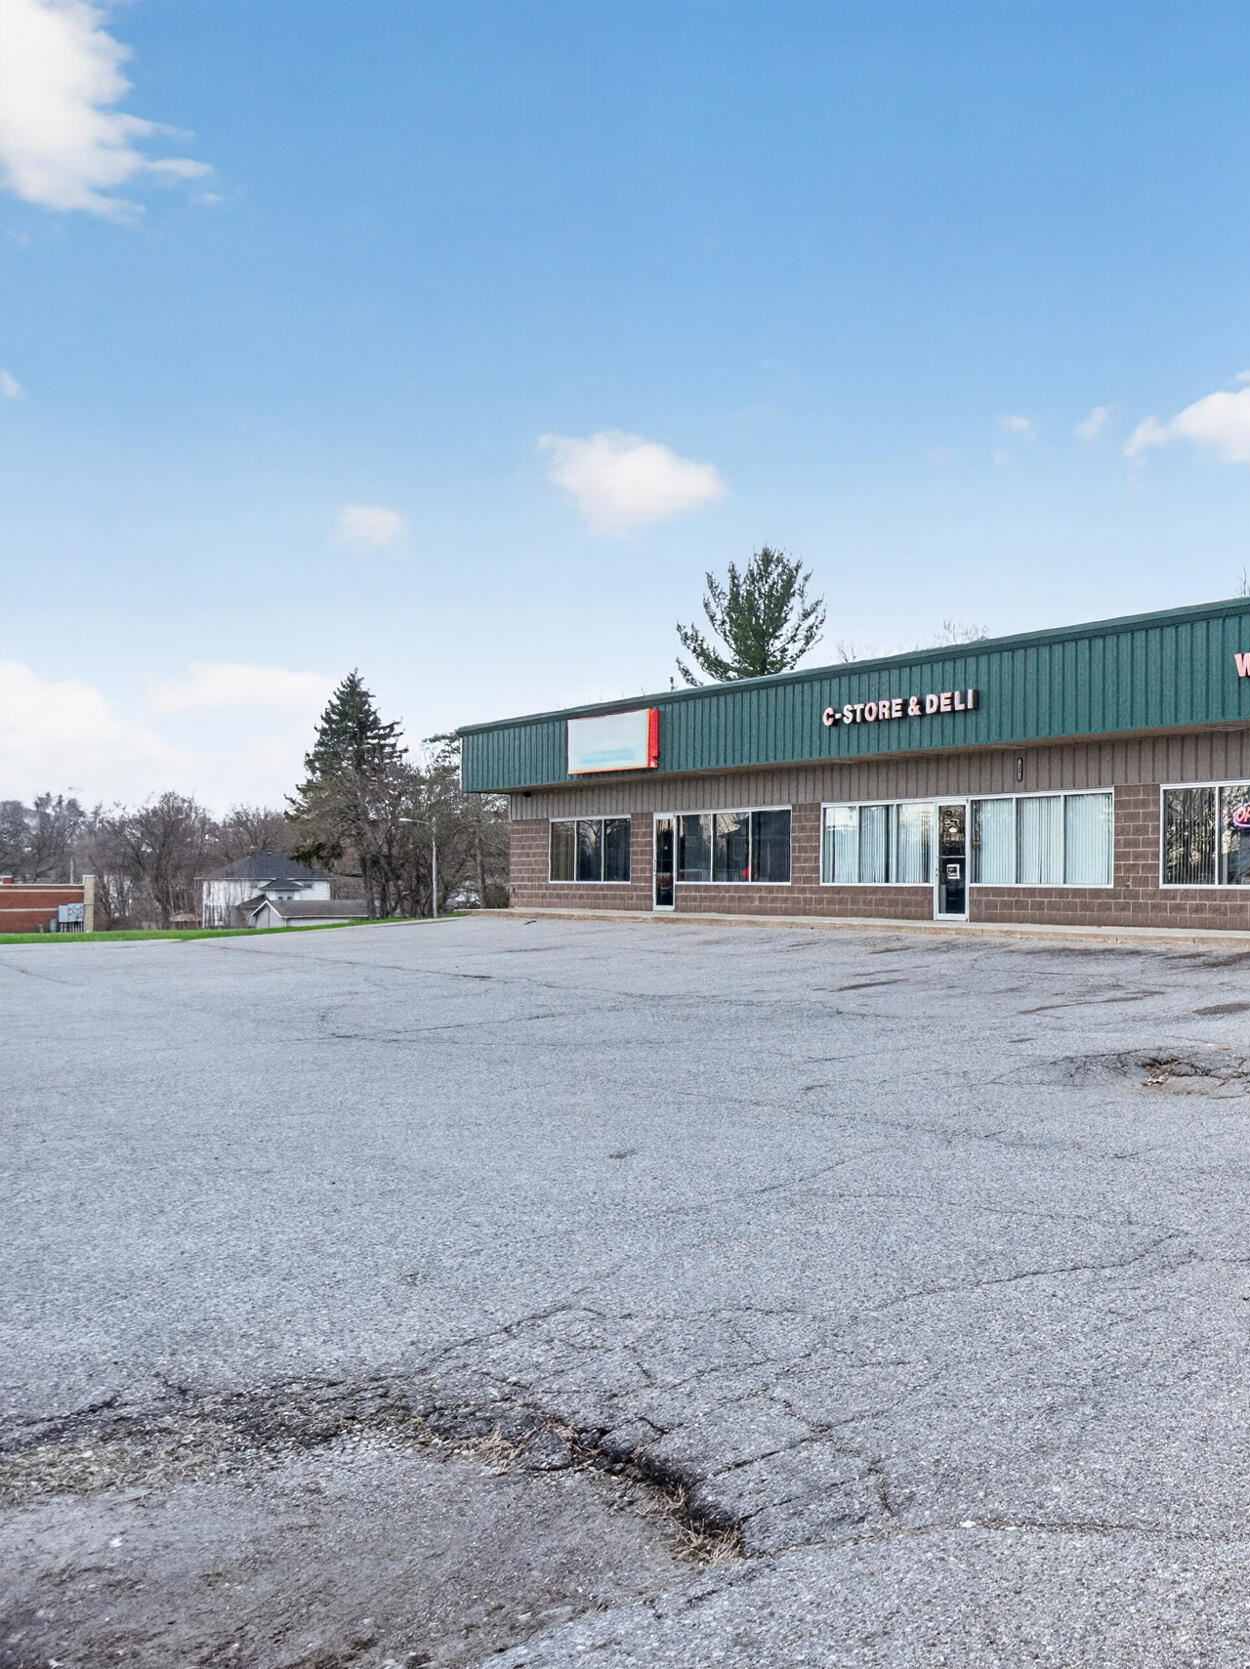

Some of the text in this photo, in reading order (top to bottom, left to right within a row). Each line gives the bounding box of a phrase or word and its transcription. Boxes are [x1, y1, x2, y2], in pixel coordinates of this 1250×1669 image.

[822, 689, 975, 727] C-STORE & DELI
